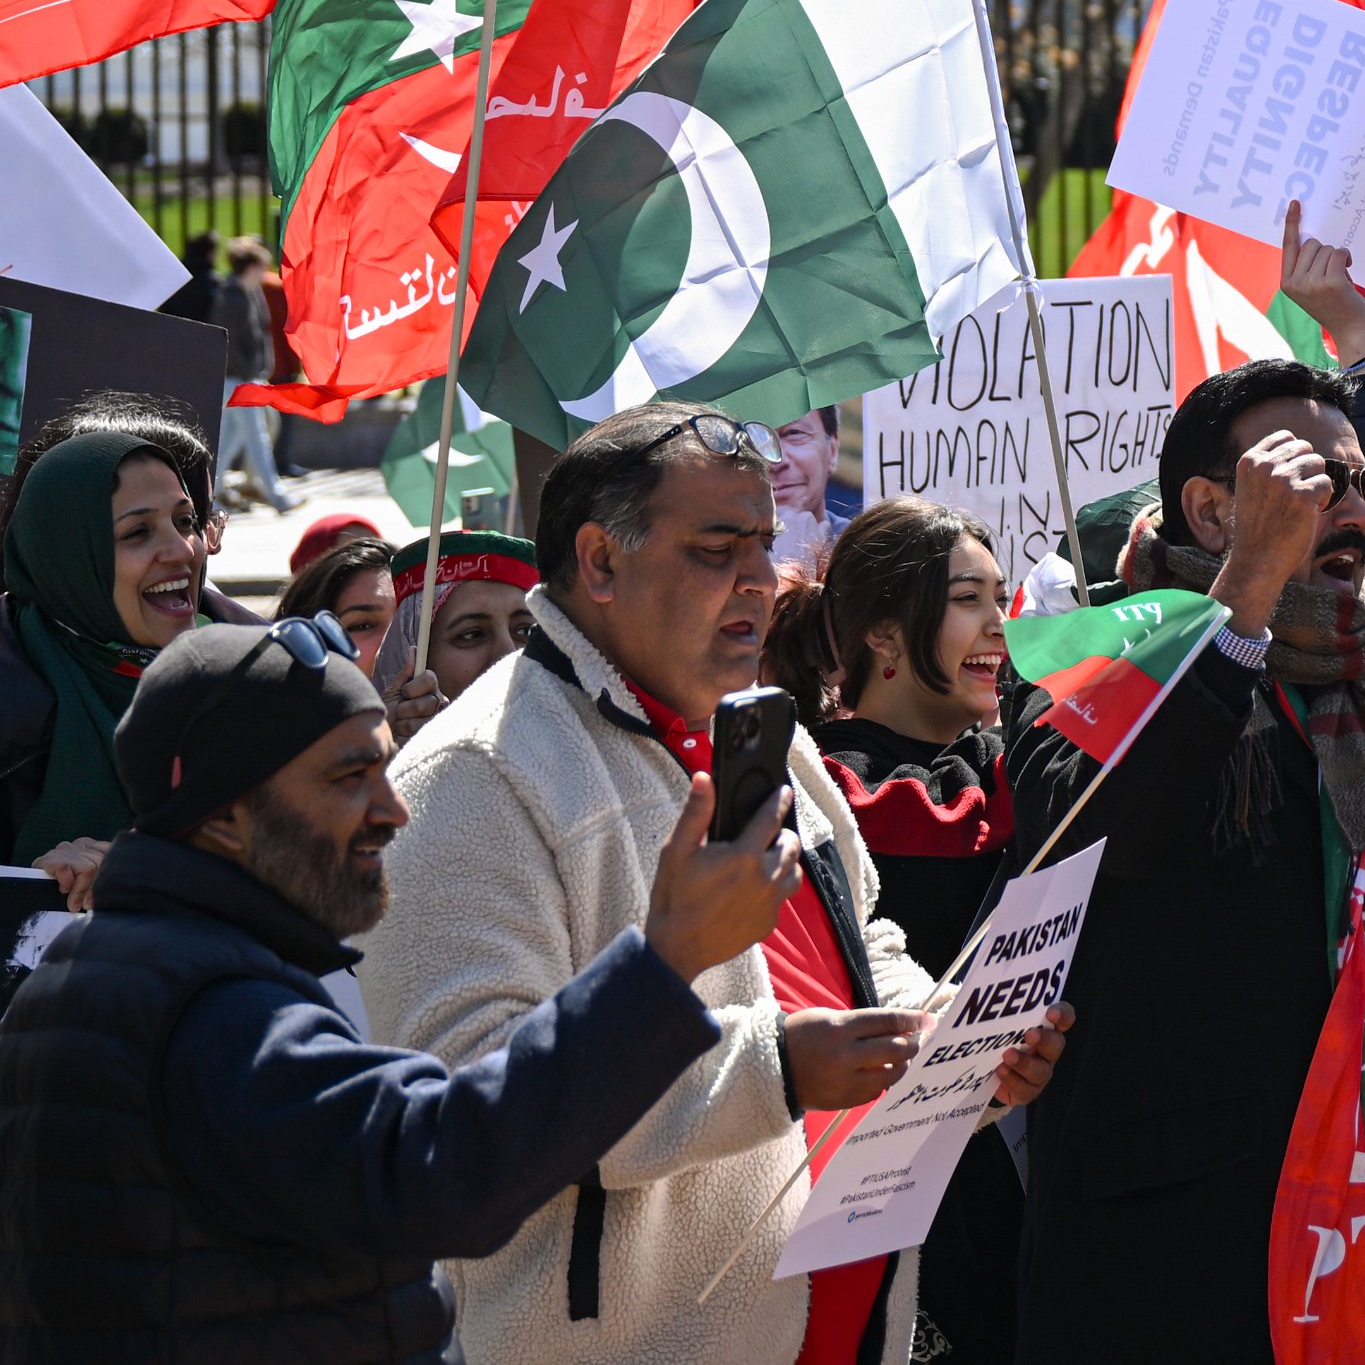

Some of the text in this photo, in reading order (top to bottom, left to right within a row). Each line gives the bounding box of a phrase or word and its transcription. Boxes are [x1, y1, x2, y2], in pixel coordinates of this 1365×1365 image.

[879, 417, 1030, 499] HUMAN
[984, 902, 1083, 967] PAKISTAN
[952, 959, 1065, 1029] NEEDS
